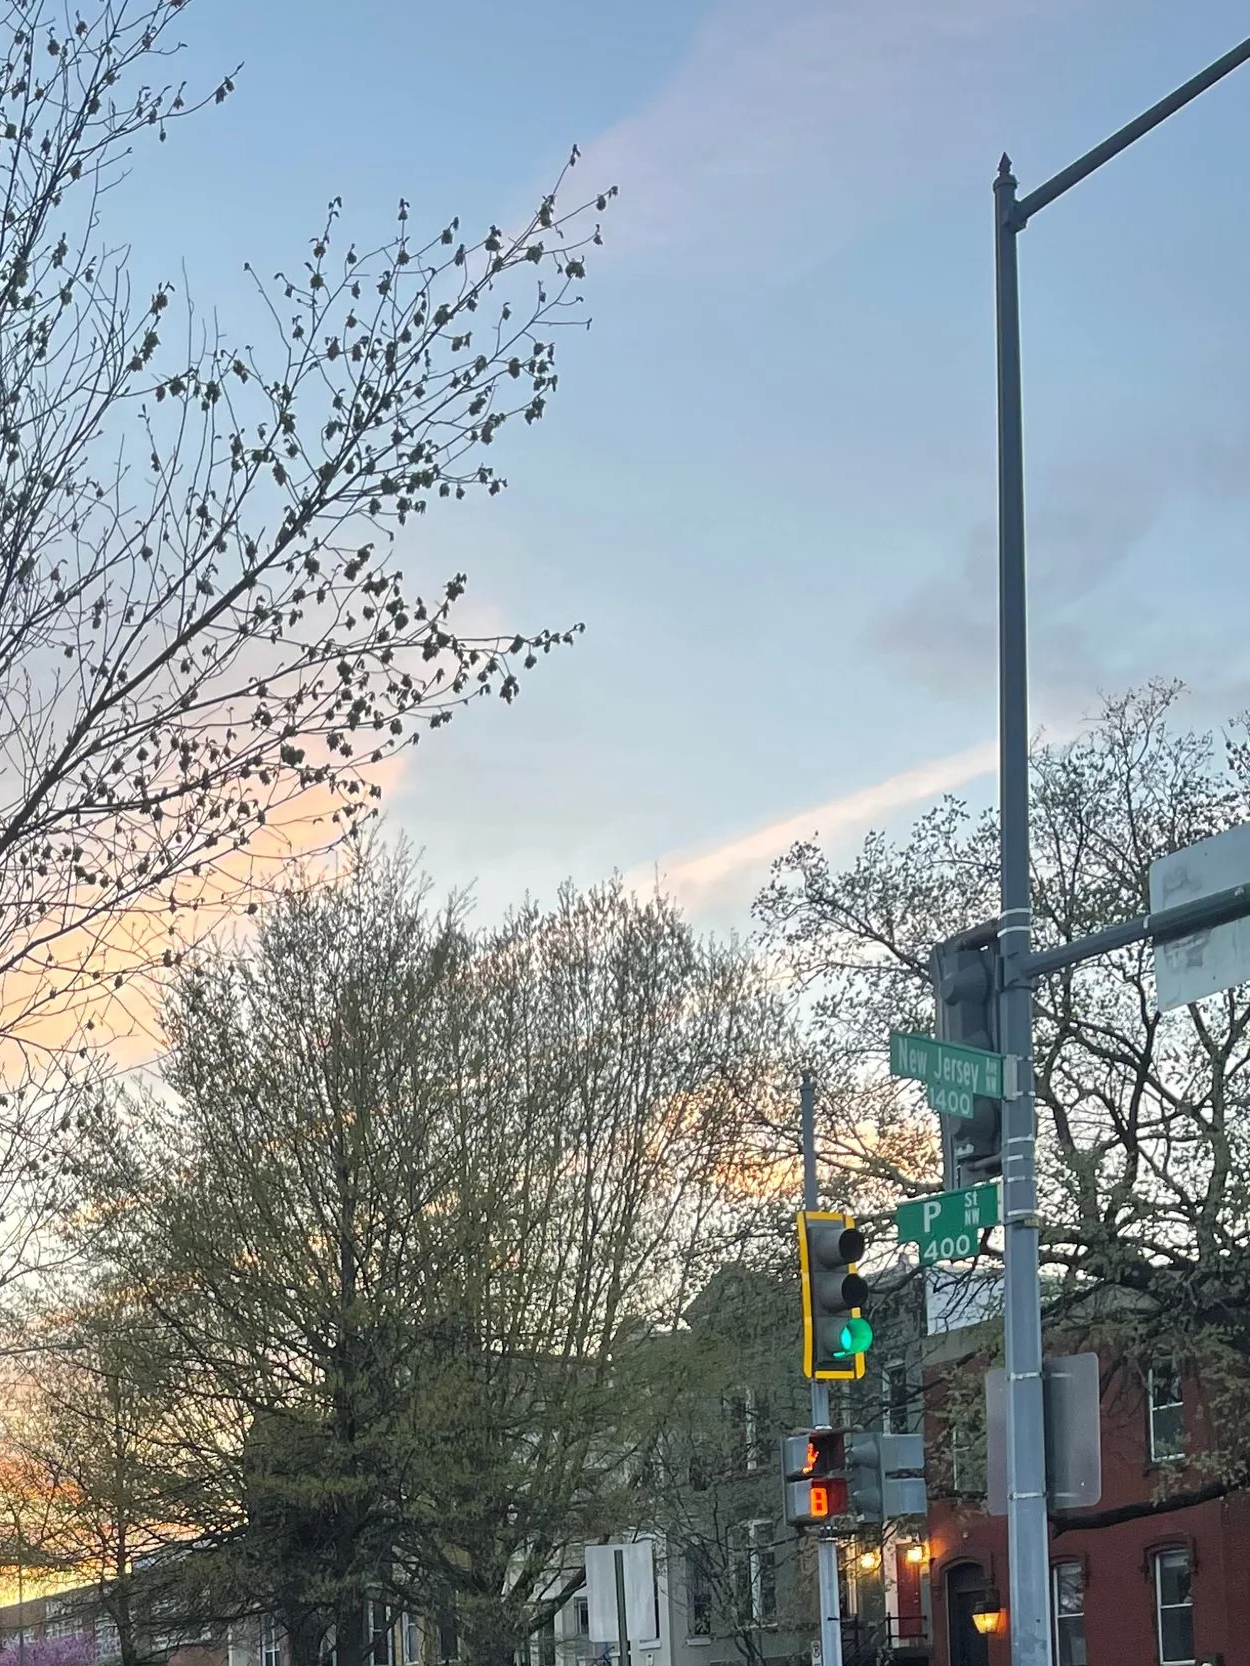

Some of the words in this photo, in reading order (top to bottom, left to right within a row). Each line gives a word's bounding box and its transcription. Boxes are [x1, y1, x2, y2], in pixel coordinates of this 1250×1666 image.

[898, 1038, 928, 1076] New
[934, 1047, 979, 1093] Jersey
[965, 1191, 978, 1208] St
[923, 1201, 942, 1233] P
[964, 1207, 980, 1226] NW
[923, 1234, 971, 1260] 400
